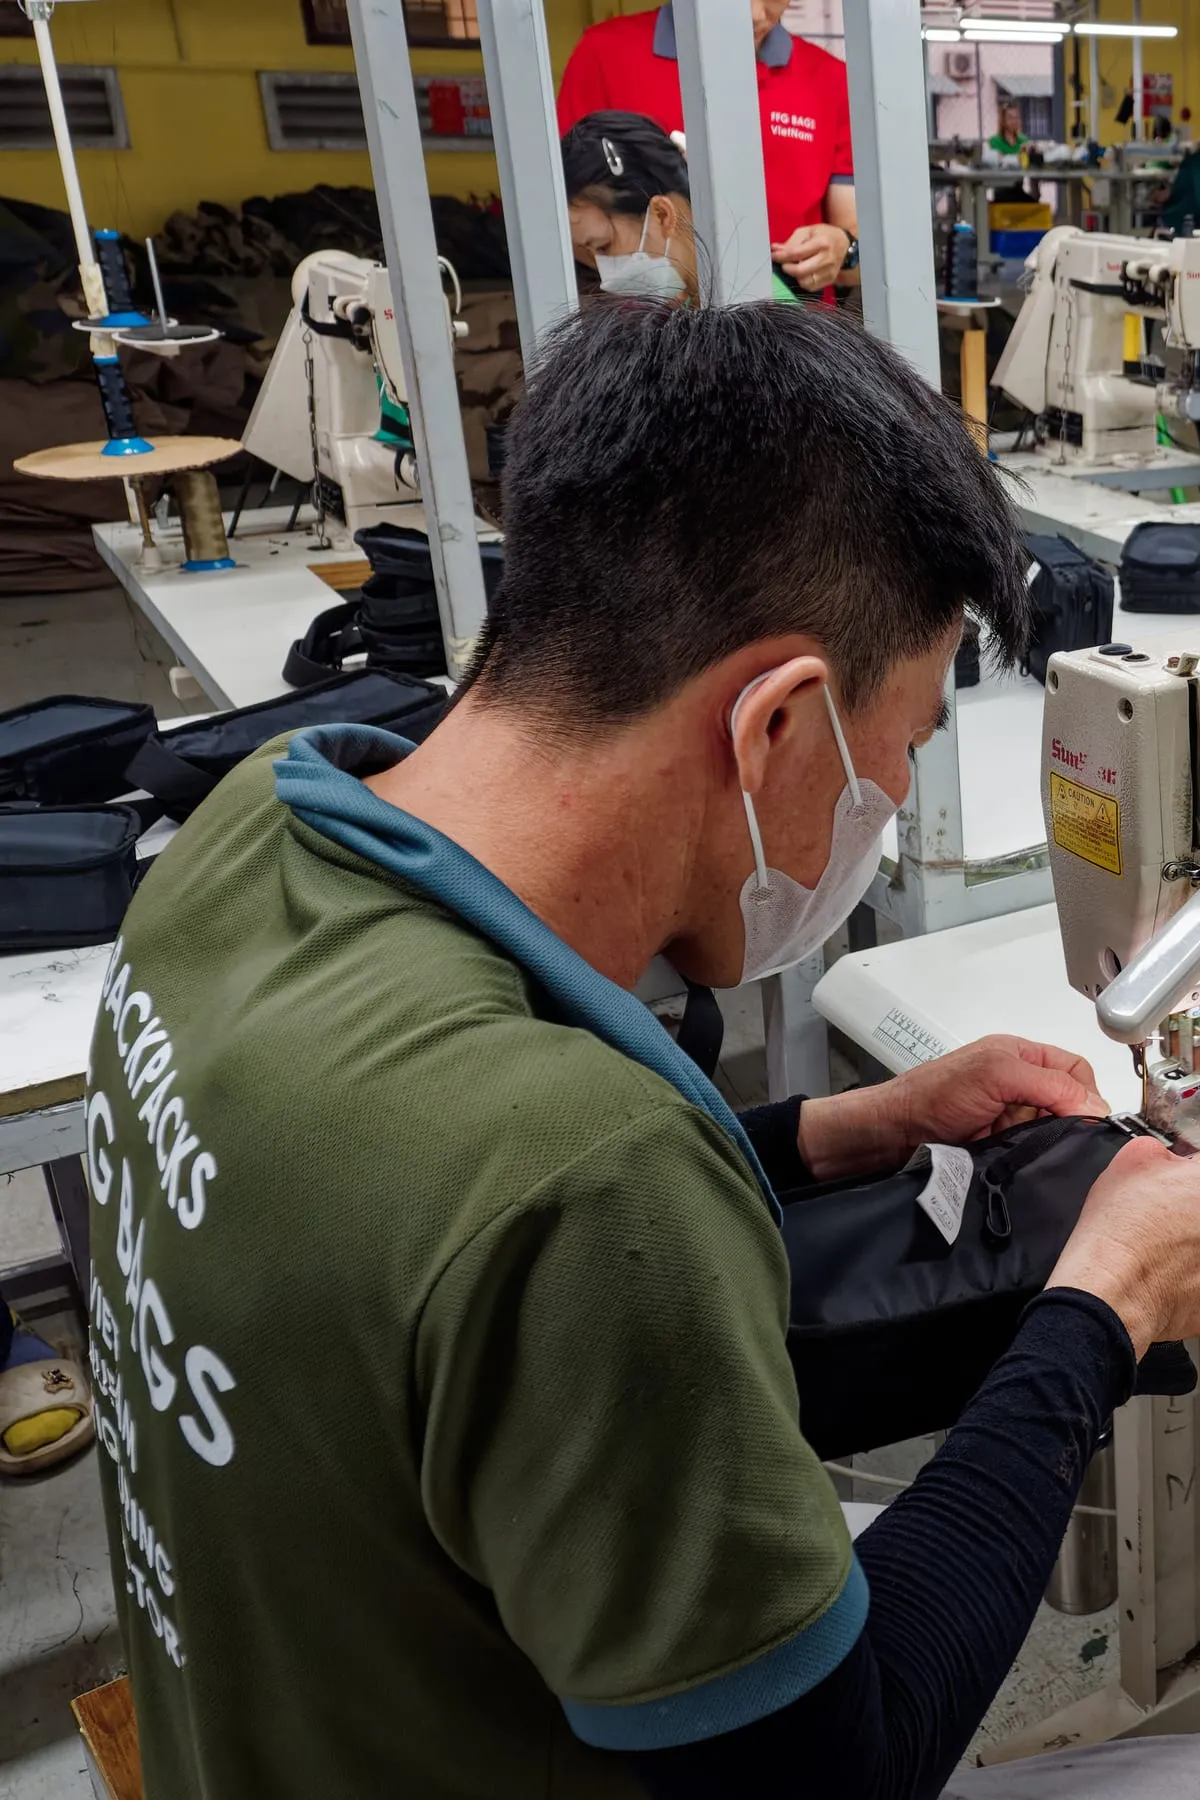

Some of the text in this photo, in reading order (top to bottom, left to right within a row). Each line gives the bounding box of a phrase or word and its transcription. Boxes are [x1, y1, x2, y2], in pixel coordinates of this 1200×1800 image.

[1068, 788, 1095, 808] CAUTION
[103, 935, 218, 1230] BACKPACKS
[116, 1156, 238, 1467] BAGS
